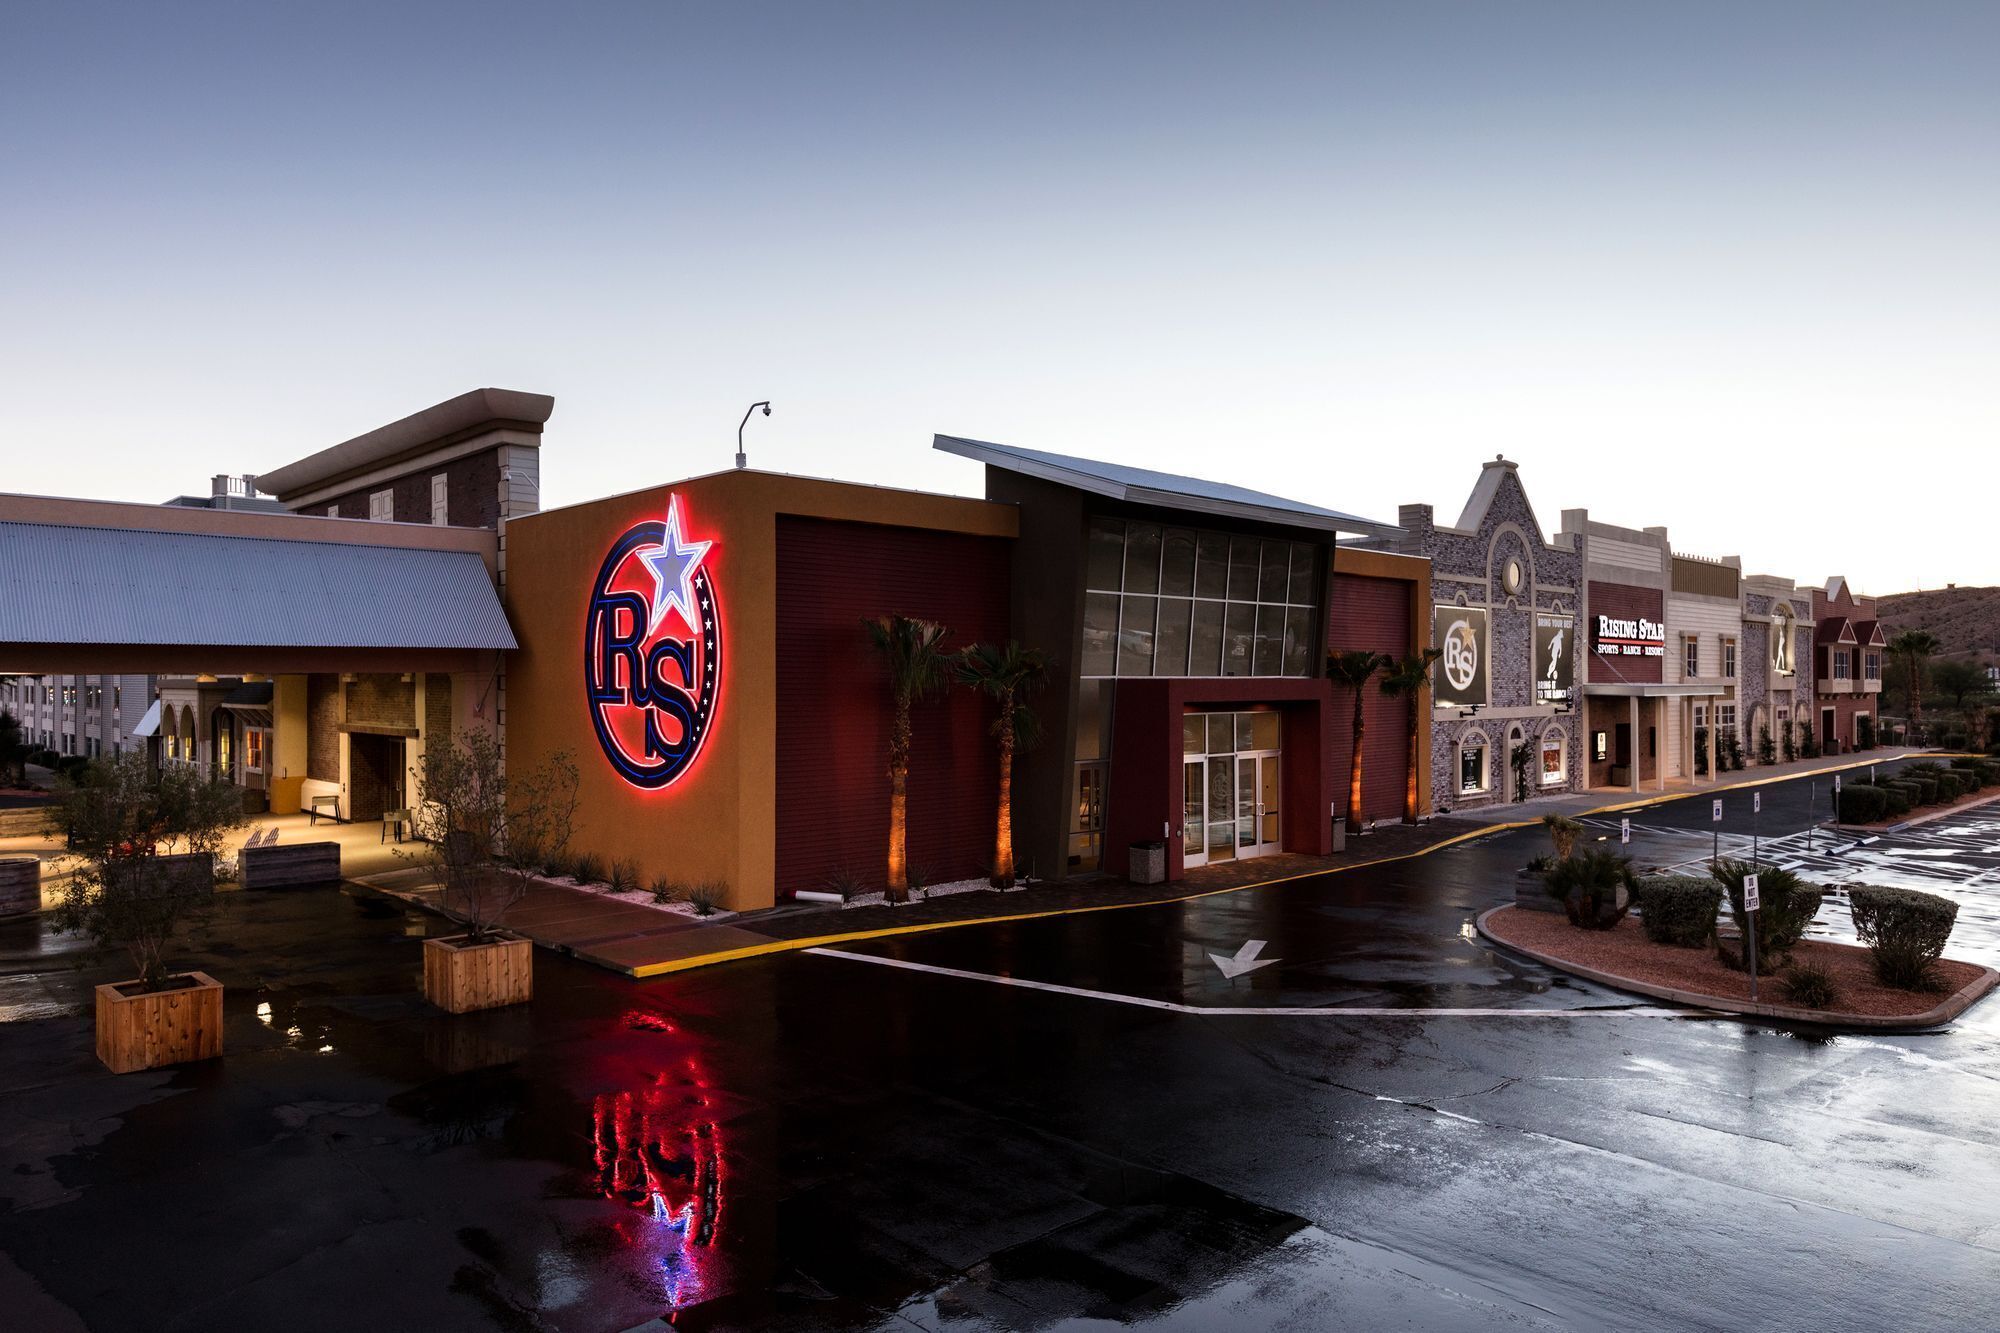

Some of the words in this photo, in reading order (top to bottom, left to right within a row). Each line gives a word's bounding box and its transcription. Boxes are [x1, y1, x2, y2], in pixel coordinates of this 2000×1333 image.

[1598, 614, 1637, 639] RISING
[1638, 618, 1665, 641] STAR
[1597, 644, 1619, 654] SPORTS
[1622, 645, 1641, 655] RANCH
[1644, 646, 1664, 656] RESORT
[1746, 897, 1758, 908] ENTER
